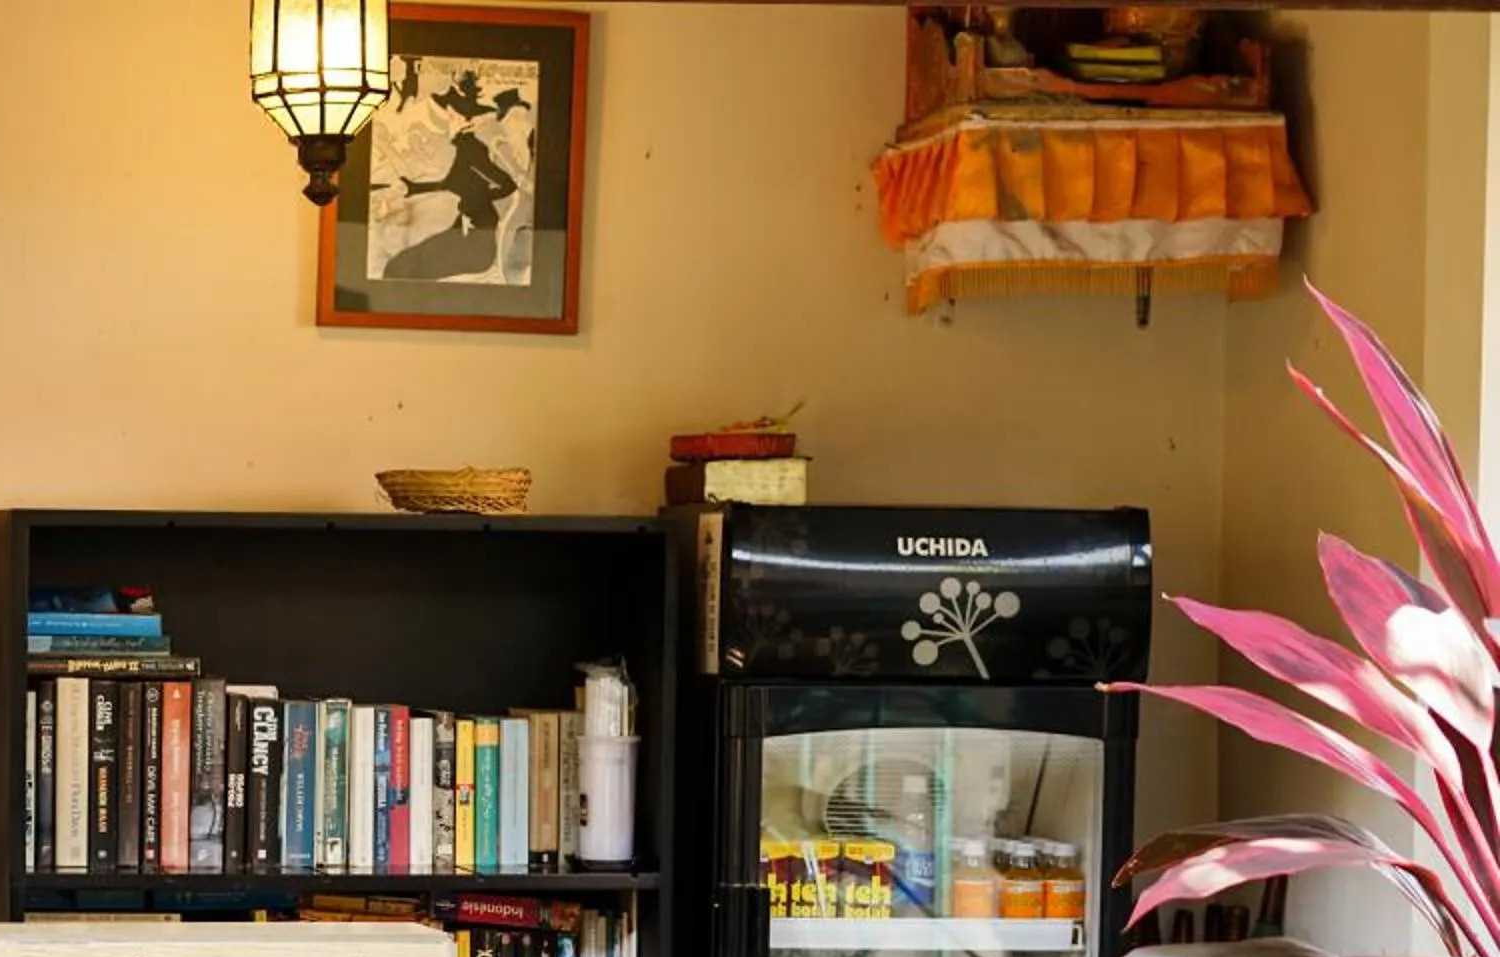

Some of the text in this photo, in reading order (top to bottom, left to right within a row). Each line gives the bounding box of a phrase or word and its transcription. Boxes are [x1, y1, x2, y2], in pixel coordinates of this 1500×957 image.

[897, 536, 988, 557] UCHIDA
[252, 706, 275, 776] CLANCY
[146, 765, 156, 790] DEVIL
[146, 793, 156, 814] MAY
[146, 816, 155, 843] CARE
[844, 875, 891, 904] teh
